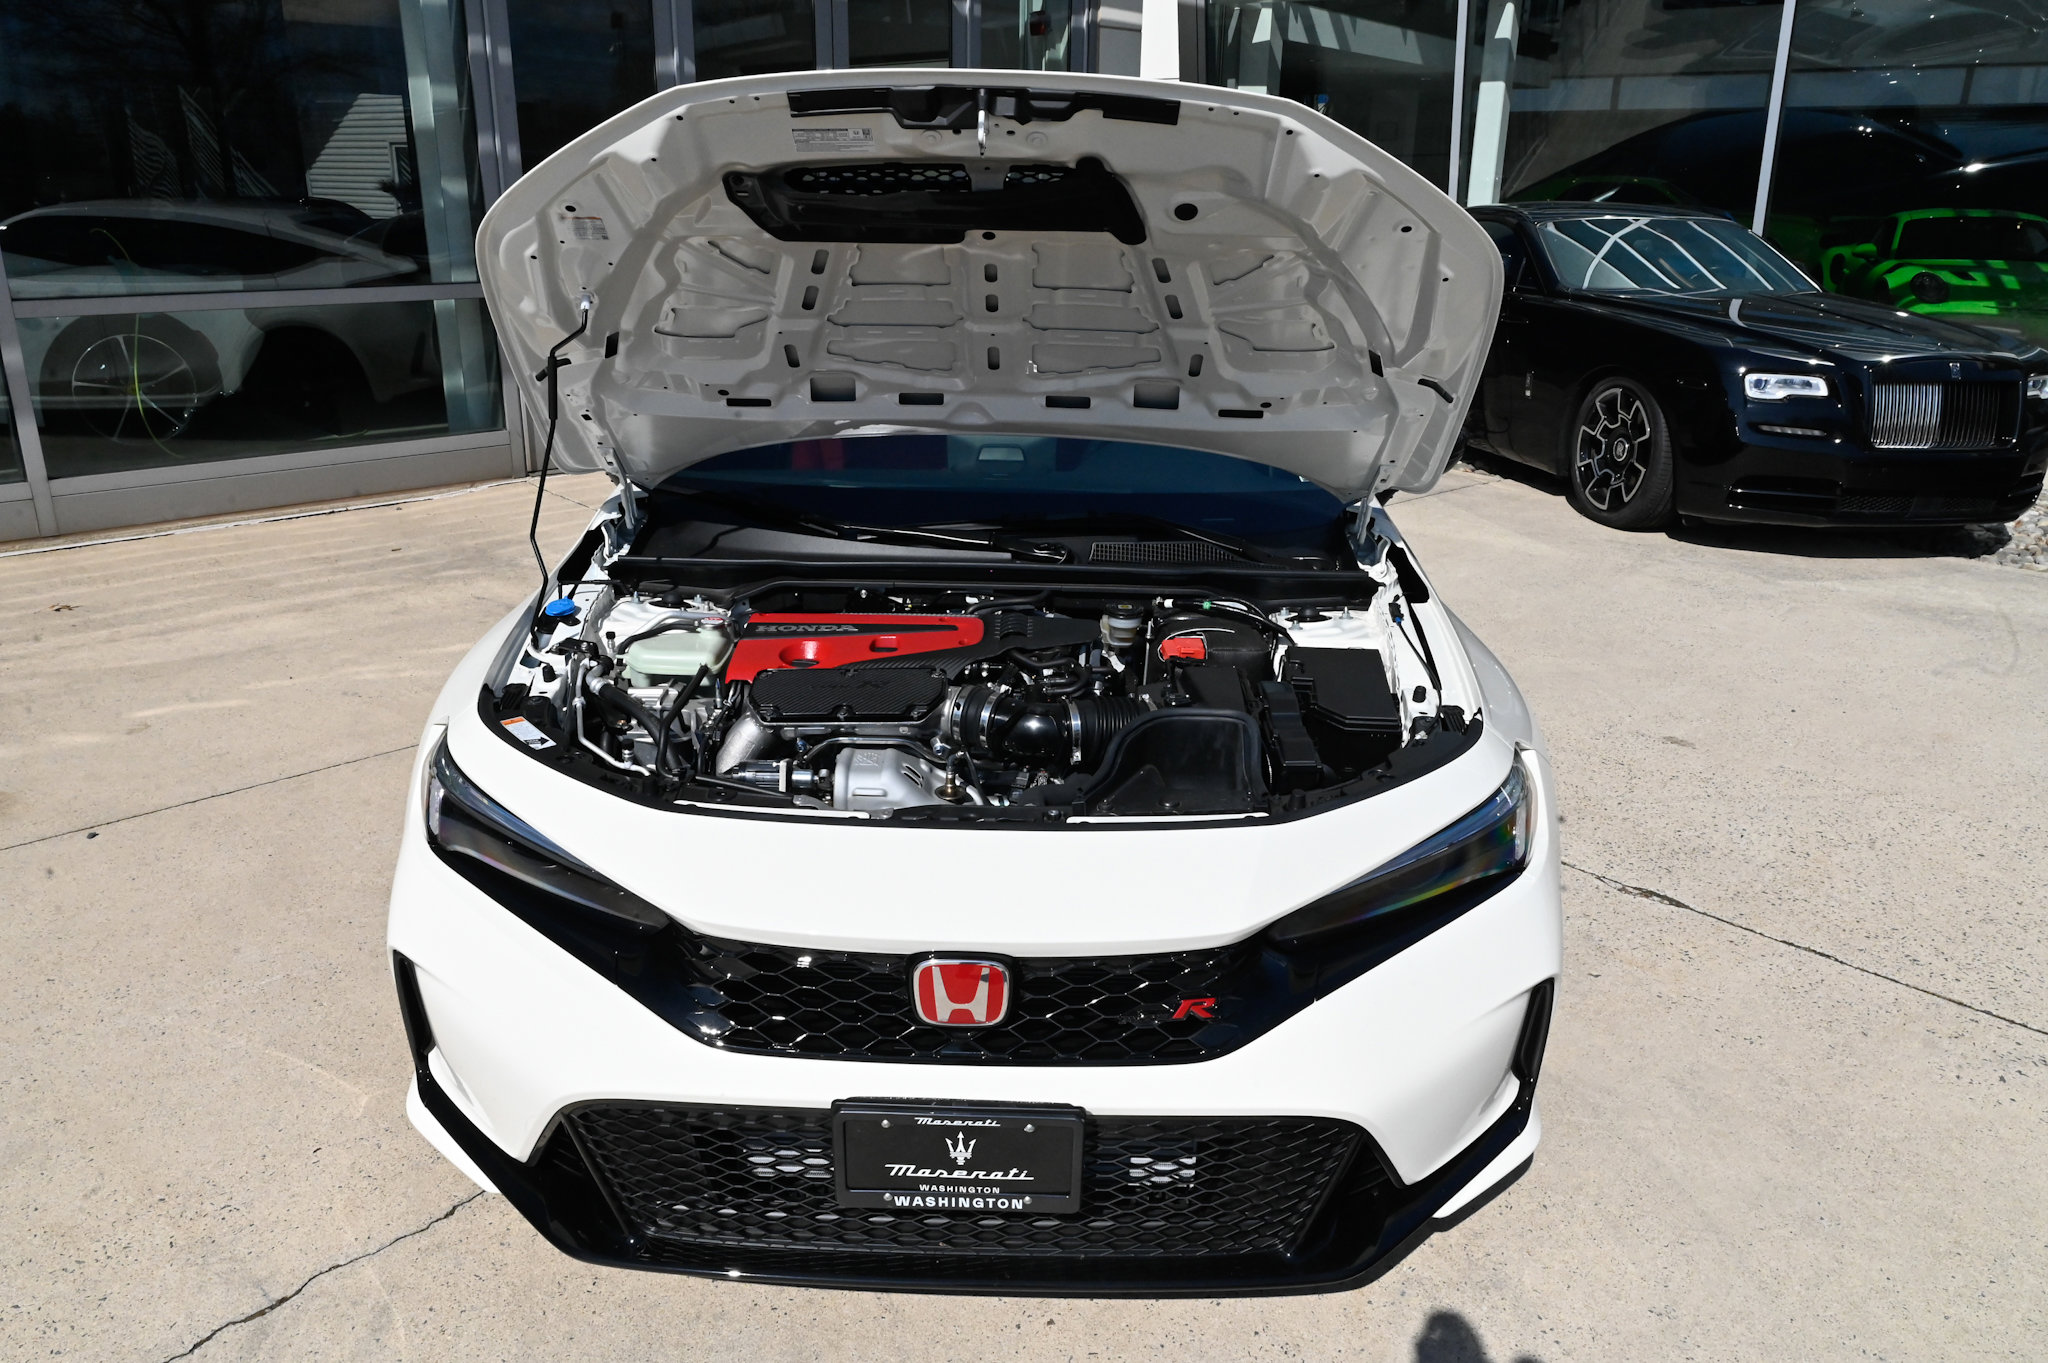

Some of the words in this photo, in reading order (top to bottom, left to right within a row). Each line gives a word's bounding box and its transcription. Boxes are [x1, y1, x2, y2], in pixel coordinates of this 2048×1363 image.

[755, 624, 859, 632] HONDA
[1171, 997, 1217, 1020] R
[914, 1117, 1001, 1127] Maserati
[885, 1164, 1033, 1181] Maserati
[919, 1184, 1000, 1194] WASHINGTON
[894, 1196, 1024, 1210] WASHINGTON
